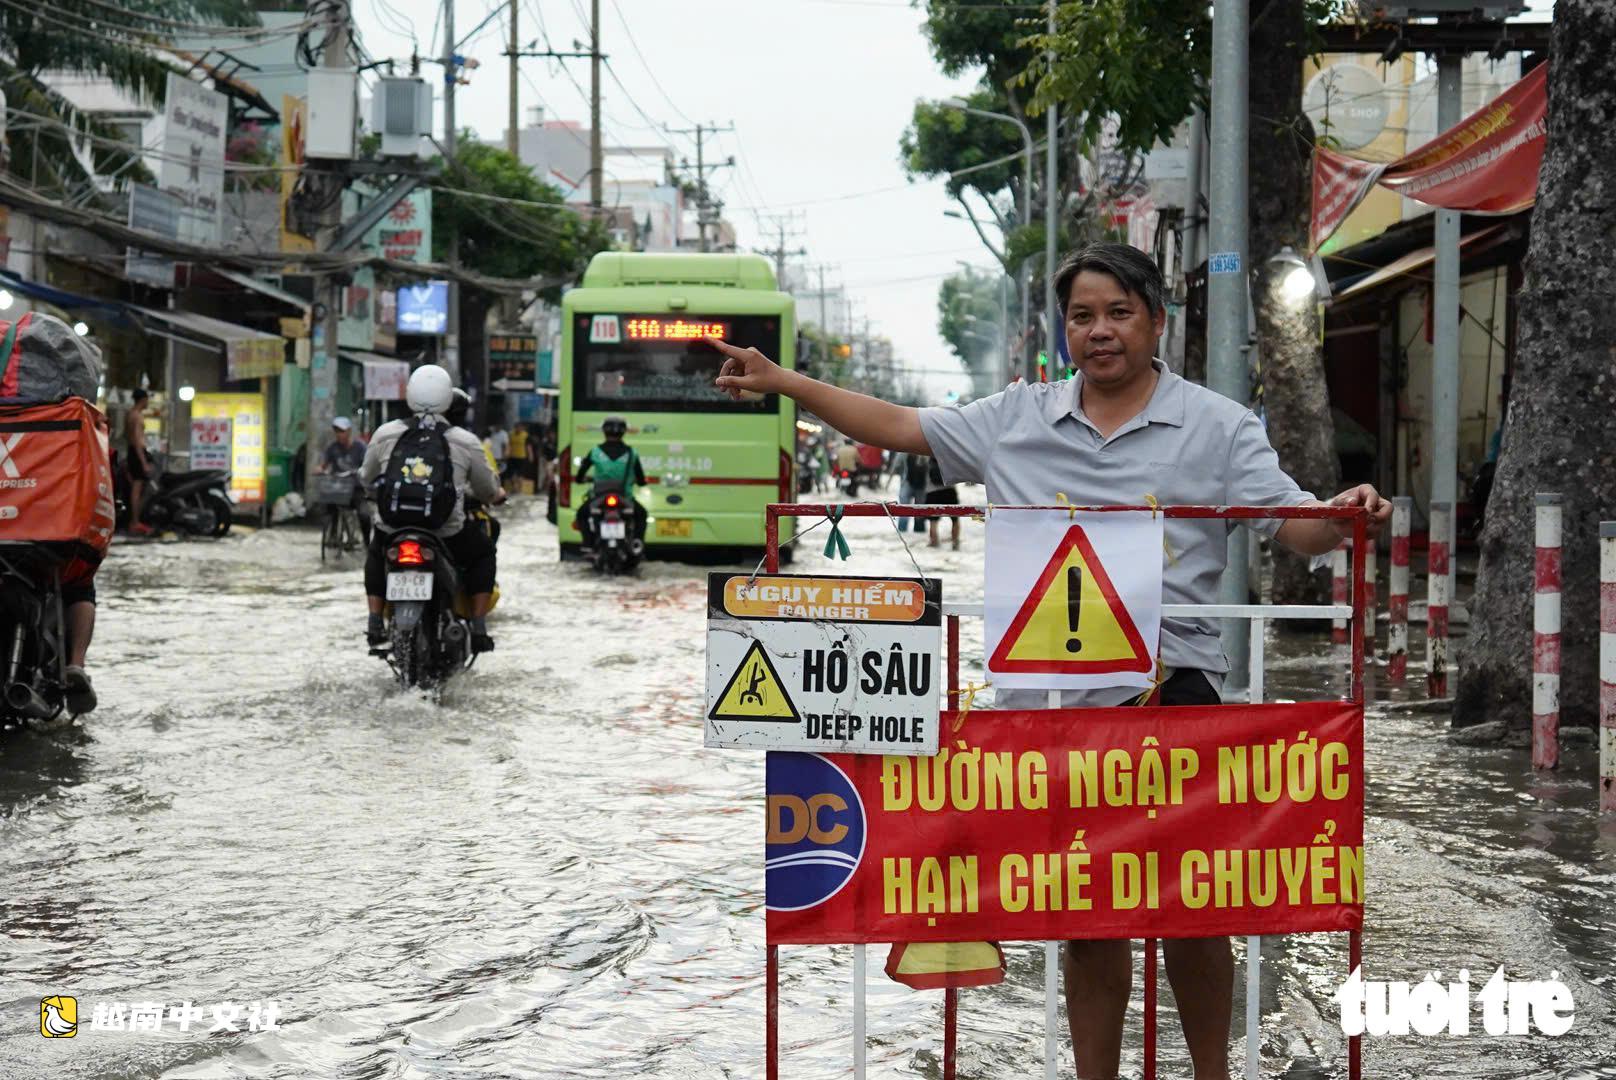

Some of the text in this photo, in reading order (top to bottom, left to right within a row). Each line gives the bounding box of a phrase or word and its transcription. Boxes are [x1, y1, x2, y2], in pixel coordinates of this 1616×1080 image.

[735, 583, 914, 606] NGUY HIỂM
[778, 604, 870, 619] DANGER
[802, 634, 932, 697] HỐ SÂU
[806, 714, 924, 743] DEEP HOLE
[879, 731, 1350, 819] ĐƯỜNG NGẬP NƯỚC
[766, 793, 849, 845] DC
[883, 819, 1364, 927] HẠN CHẾ DI CHUYỂN
